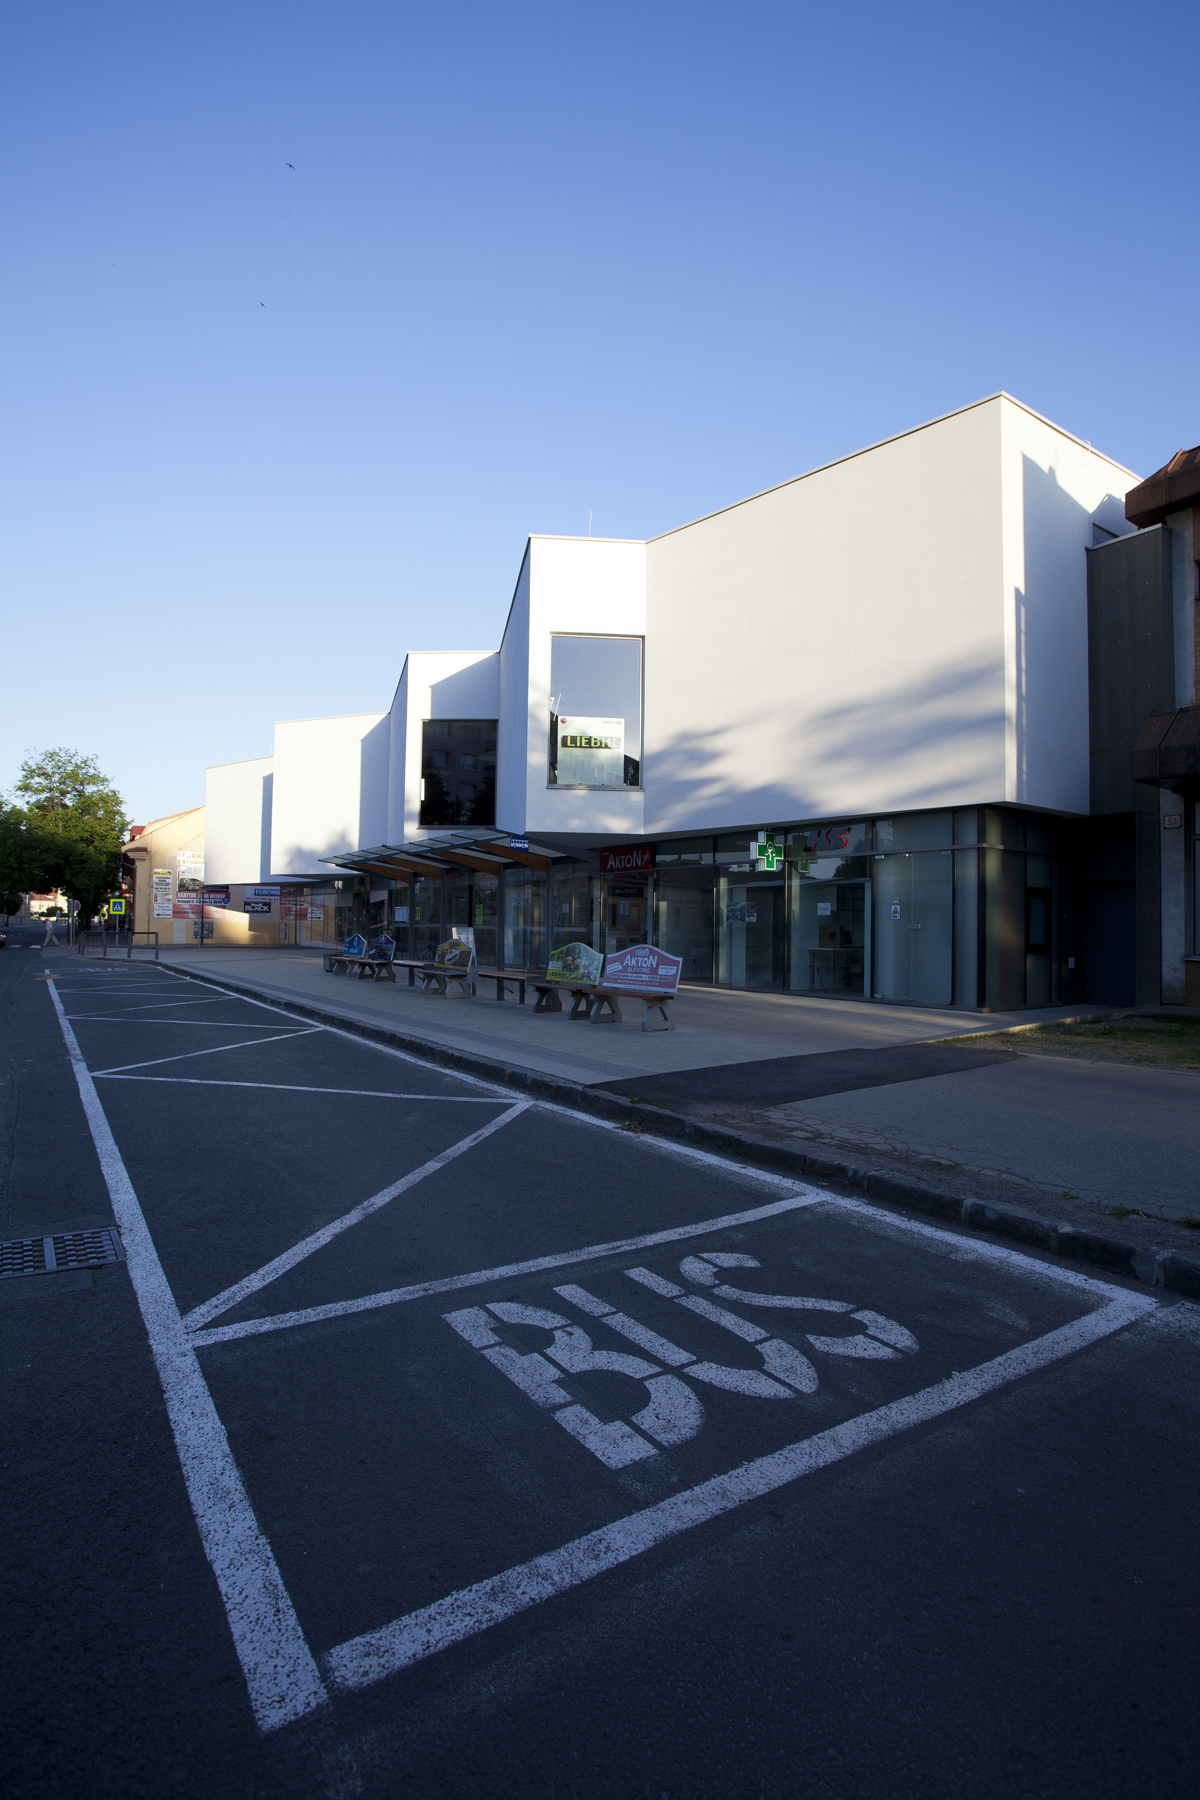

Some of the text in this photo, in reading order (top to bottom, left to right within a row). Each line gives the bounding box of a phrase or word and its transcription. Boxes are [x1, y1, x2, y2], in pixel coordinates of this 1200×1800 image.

[1167, 817, 1177, 826] 53
[606, 849, 642, 870] AKTON
[623, 954, 658, 968] AKTON
[627, 966, 651, 974] ELEKTRO
[439, 1252, 920, 1471] BUS
